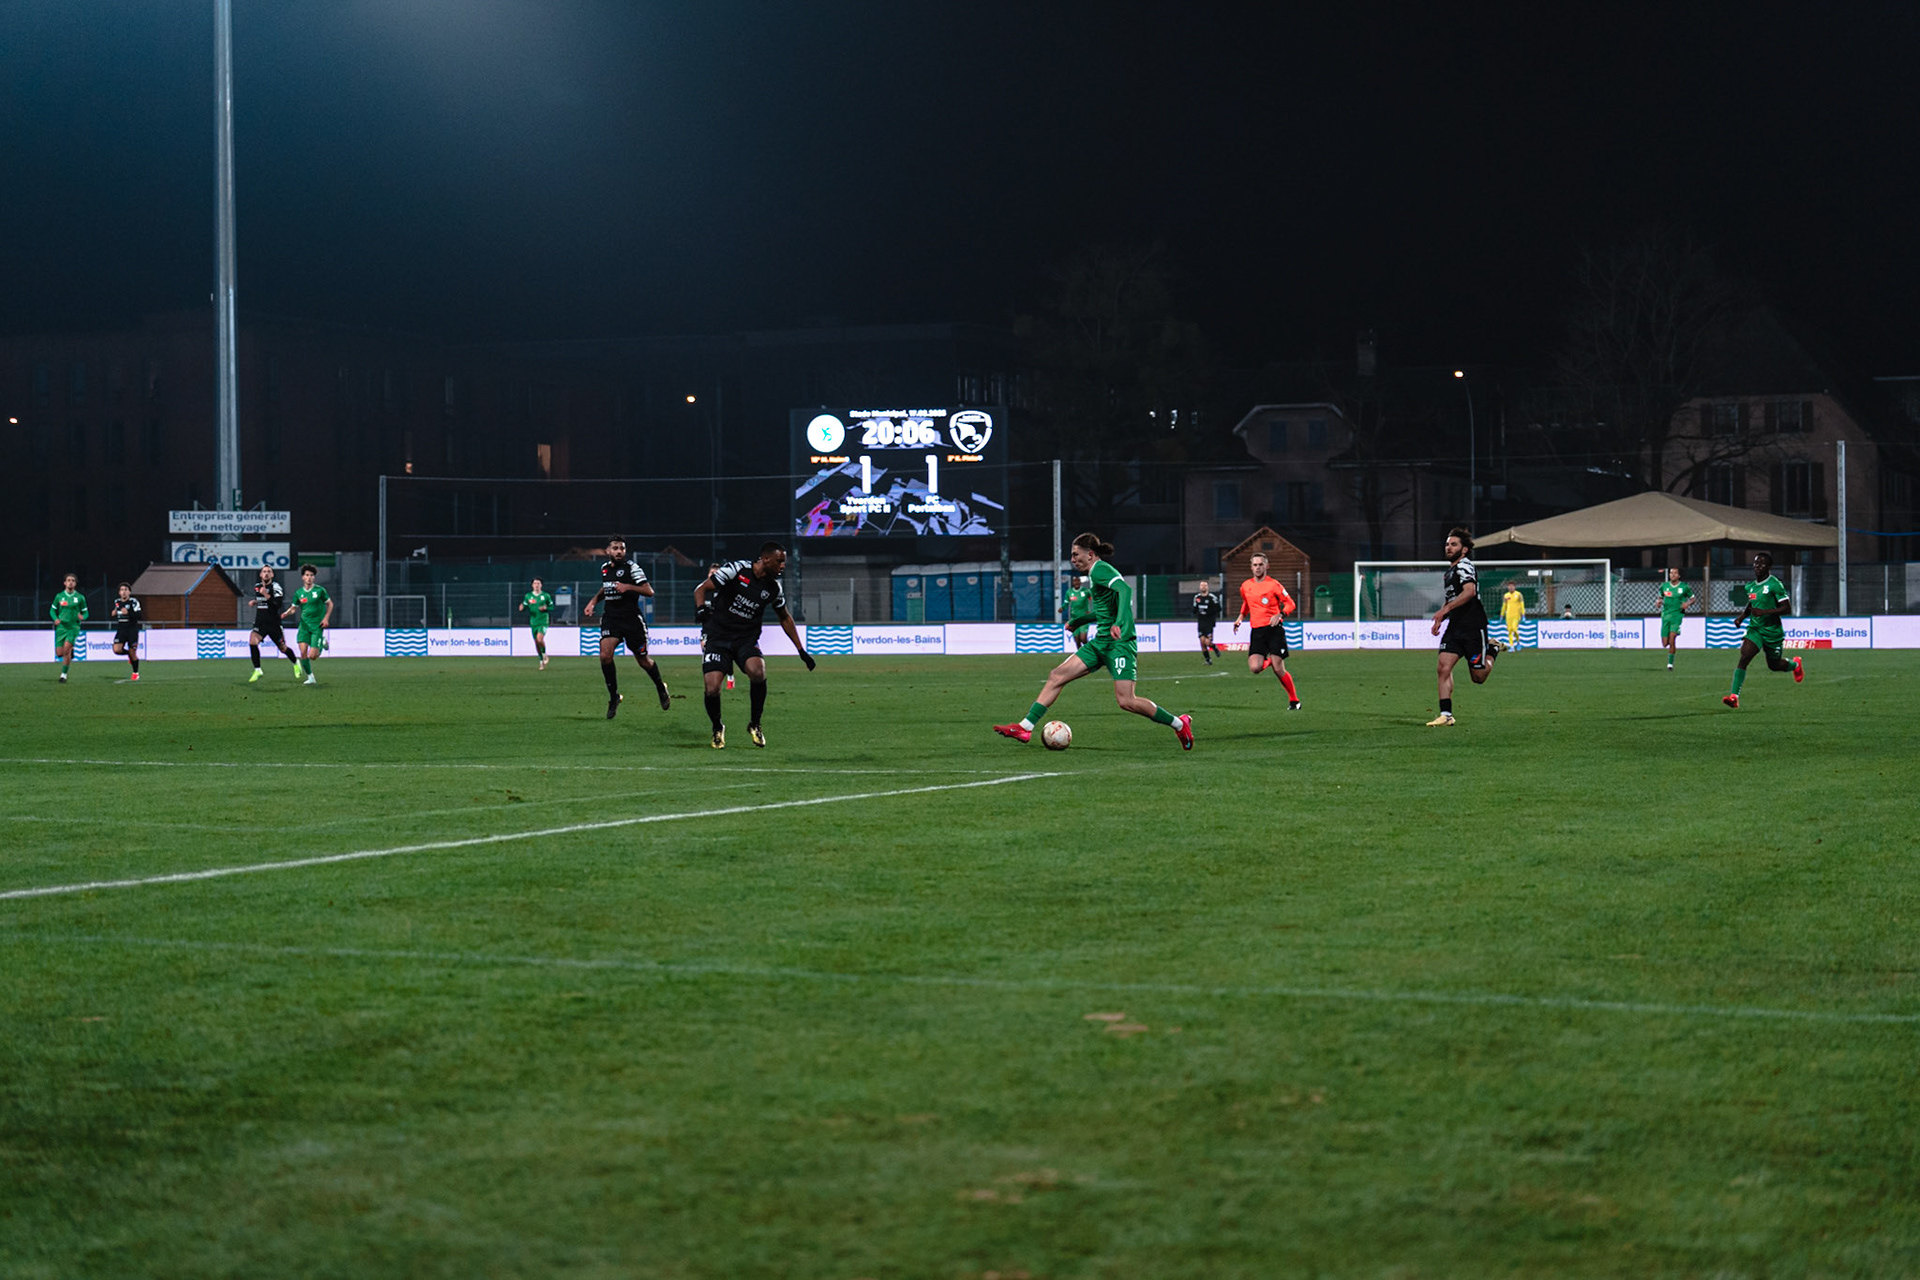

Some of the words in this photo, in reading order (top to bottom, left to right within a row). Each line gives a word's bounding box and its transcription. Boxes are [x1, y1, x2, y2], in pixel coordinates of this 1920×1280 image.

[861, 420, 936, 445] 20:06
[859, 455, 872, 494] 1
[925, 454, 938, 493] 1
[846, 496, 887, 505] Yverdon
[925, 496, 940, 504] FC
[840, 504, 868, 515] Sport
[868, 504, 882, 513] FC
[172, 511, 234, 522] Entreprise
[236, 512, 288, 523] générale
[193, 523, 207, 531] de
[210, 523, 267, 534] nettoyage
[1305, 631, 1401, 641] Yverdon-ls-Bains
[1540, 630, 1641, 640] Yverdon-lesBains
[1783, 628, 1868, 638] rdon-les-Bains
[854, 635, 942, 644] Yverdon-les-Bains
[1114, 657, 1126, 669] 10
